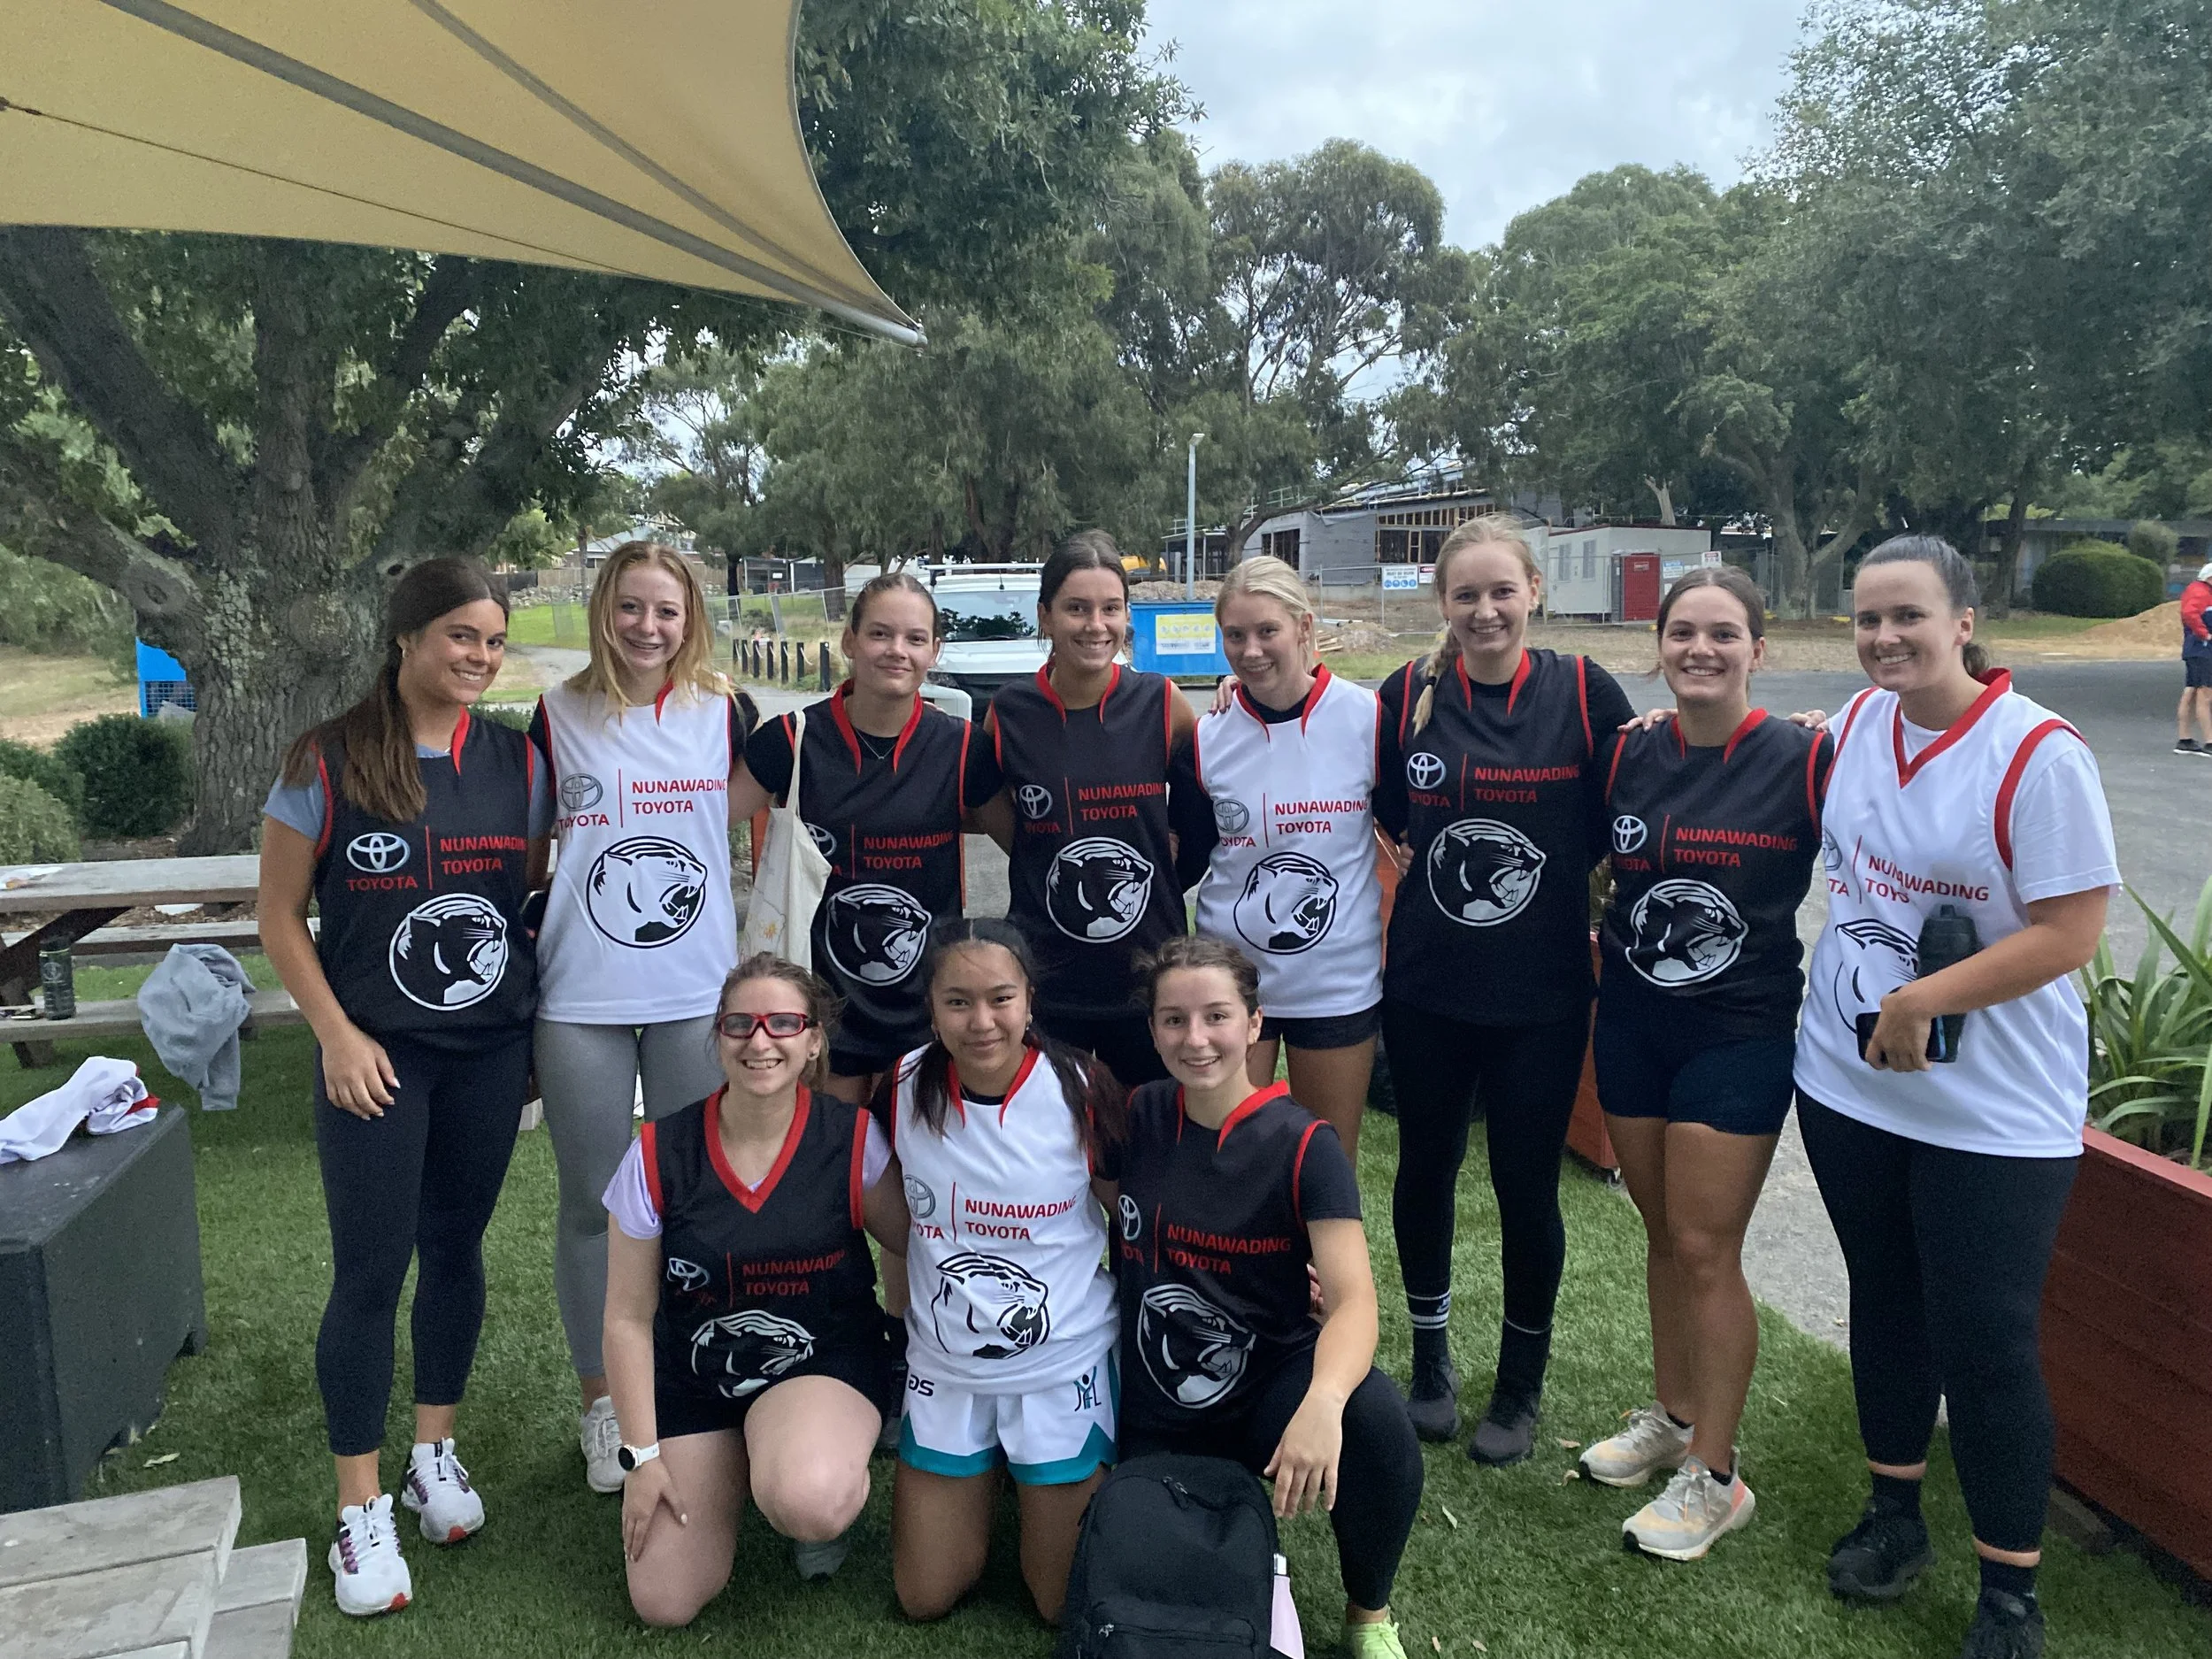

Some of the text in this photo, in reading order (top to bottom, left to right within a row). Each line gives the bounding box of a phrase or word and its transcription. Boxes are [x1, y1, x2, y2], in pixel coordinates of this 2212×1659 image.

[1474, 764, 1579, 782] NUNAWADING
[1474, 788, 1538, 803] TOYOTA
[632, 800, 694, 814] TOYOTA
[1080, 804, 1138, 821] TOYOTA
[1275, 799, 1368, 816] NUNAWADING
[558, 813, 610, 831] TOYOTA
[1276, 821, 1332, 835] TOYOTA
[1220, 836, 1256, 848] OYOTA
[1676, 827, 1797, 851] NUNAWADING
[441, 857, 503, 875] TOYOTA
[864, 856, 923, 870] TOYOTA
[1674, 849, 1741, 868] TOYOTA
[346, 875, 419, 892] TOYOTA
[965, 1195, 1077, 1219] NUNAWADING
[912, 1221, 945, 1239] OTA
[964, 1221, 1031, 1241] TOYOTA
[1167, 1224, 1291, 1255] NUNAWADING
[742, 1249, 845, 1277] NUNAWADIN
[1167, 1248, 1232, 1275] TOYOTA
[744, 1280, 810, 1296] TOYOTA
